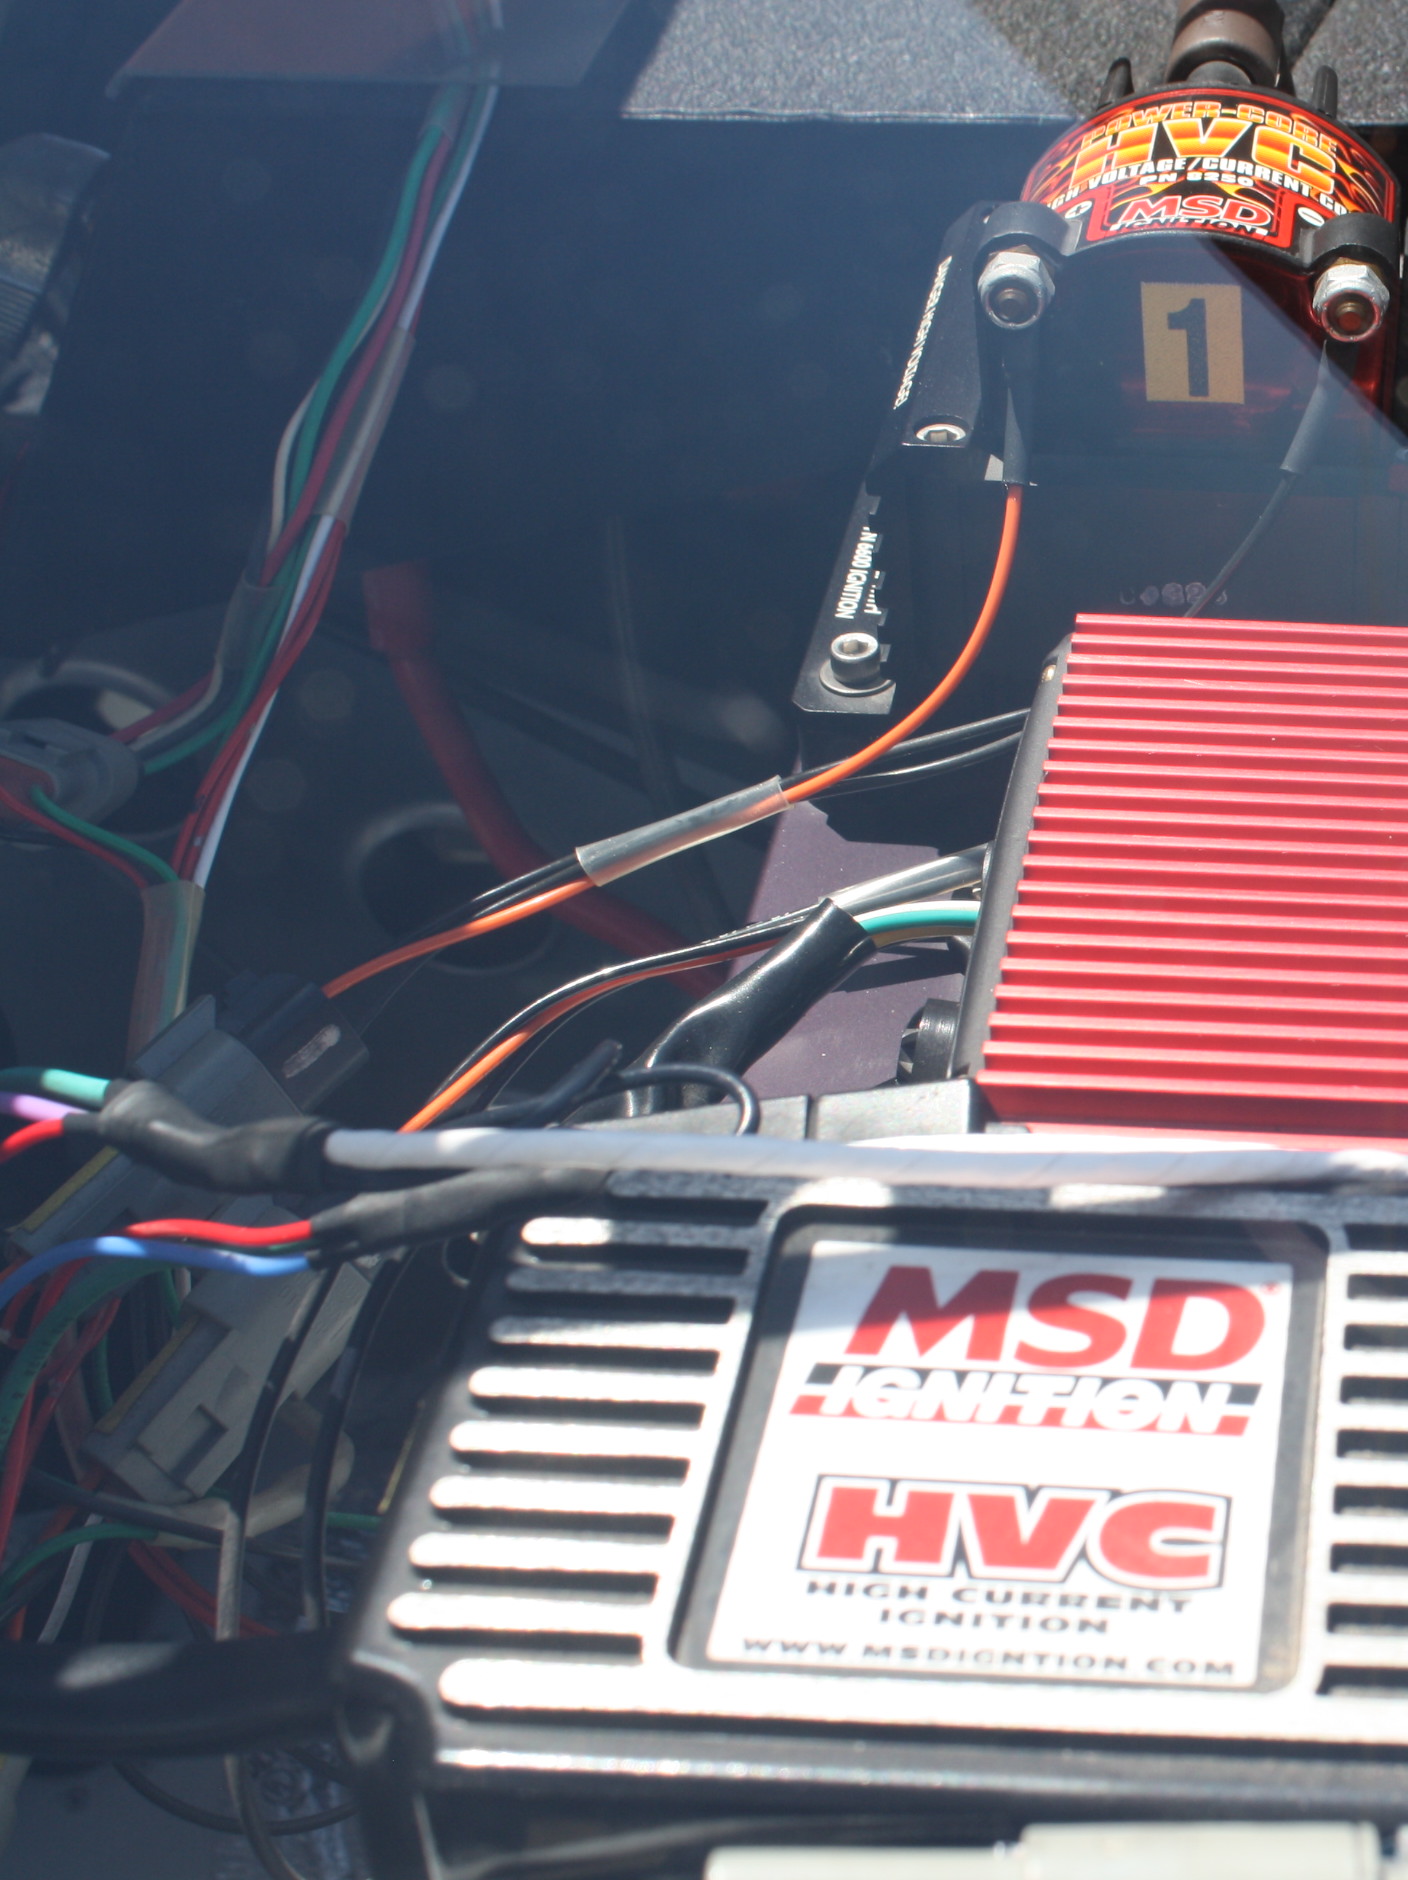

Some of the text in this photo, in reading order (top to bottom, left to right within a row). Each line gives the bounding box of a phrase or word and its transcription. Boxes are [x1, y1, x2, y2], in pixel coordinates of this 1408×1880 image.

[1080, 100, 1339, 156] POWER-CORE
[1069, 117, 1337, 195] HVC
[1087, 156, 1313, 198] VOLTAGE/CURRENT
[1139, 171, 1255, 188] PN 8250
[1117, 195, 1272, 227] MSD
[1167, 296, 1210, 397] 1
[852, 542, 874, 569] 6600
[835, 569, 869, 620] IGNITION
[844, 1265, 1266, 1372] MSD
[820, 1365, 1233, 1434] IGNITION
[798, 1474, 1232, 1591] HVC
[806, 1580, 1193, 1614] HIGH CURRENT
[880, 1609, 1110, 1634] IGNITION
